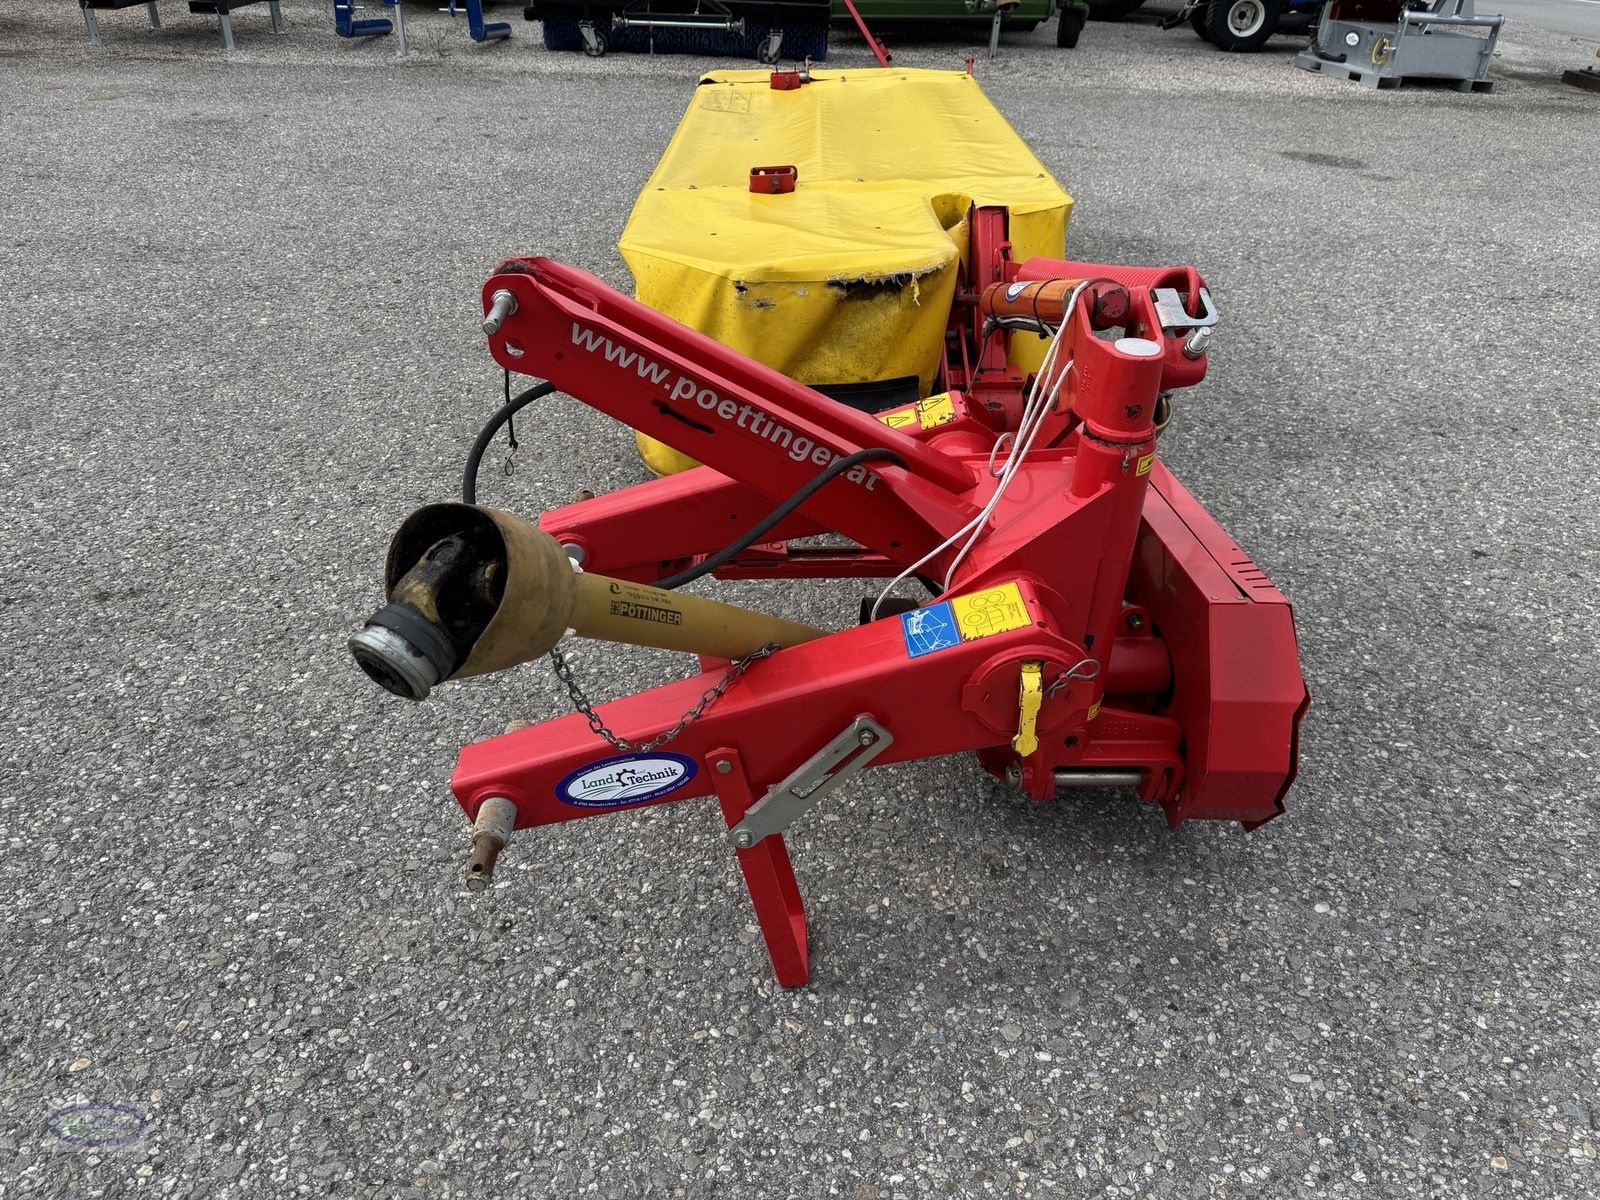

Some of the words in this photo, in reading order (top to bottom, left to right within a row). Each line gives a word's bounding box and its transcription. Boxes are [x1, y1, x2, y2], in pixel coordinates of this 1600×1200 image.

[570, 322, 881, 491] www.poettingerat
[620, 602, 681, 625] PÖTTINGER
[581, 774, 615, 790] Land
[627, 767, 678, 785] Technik
